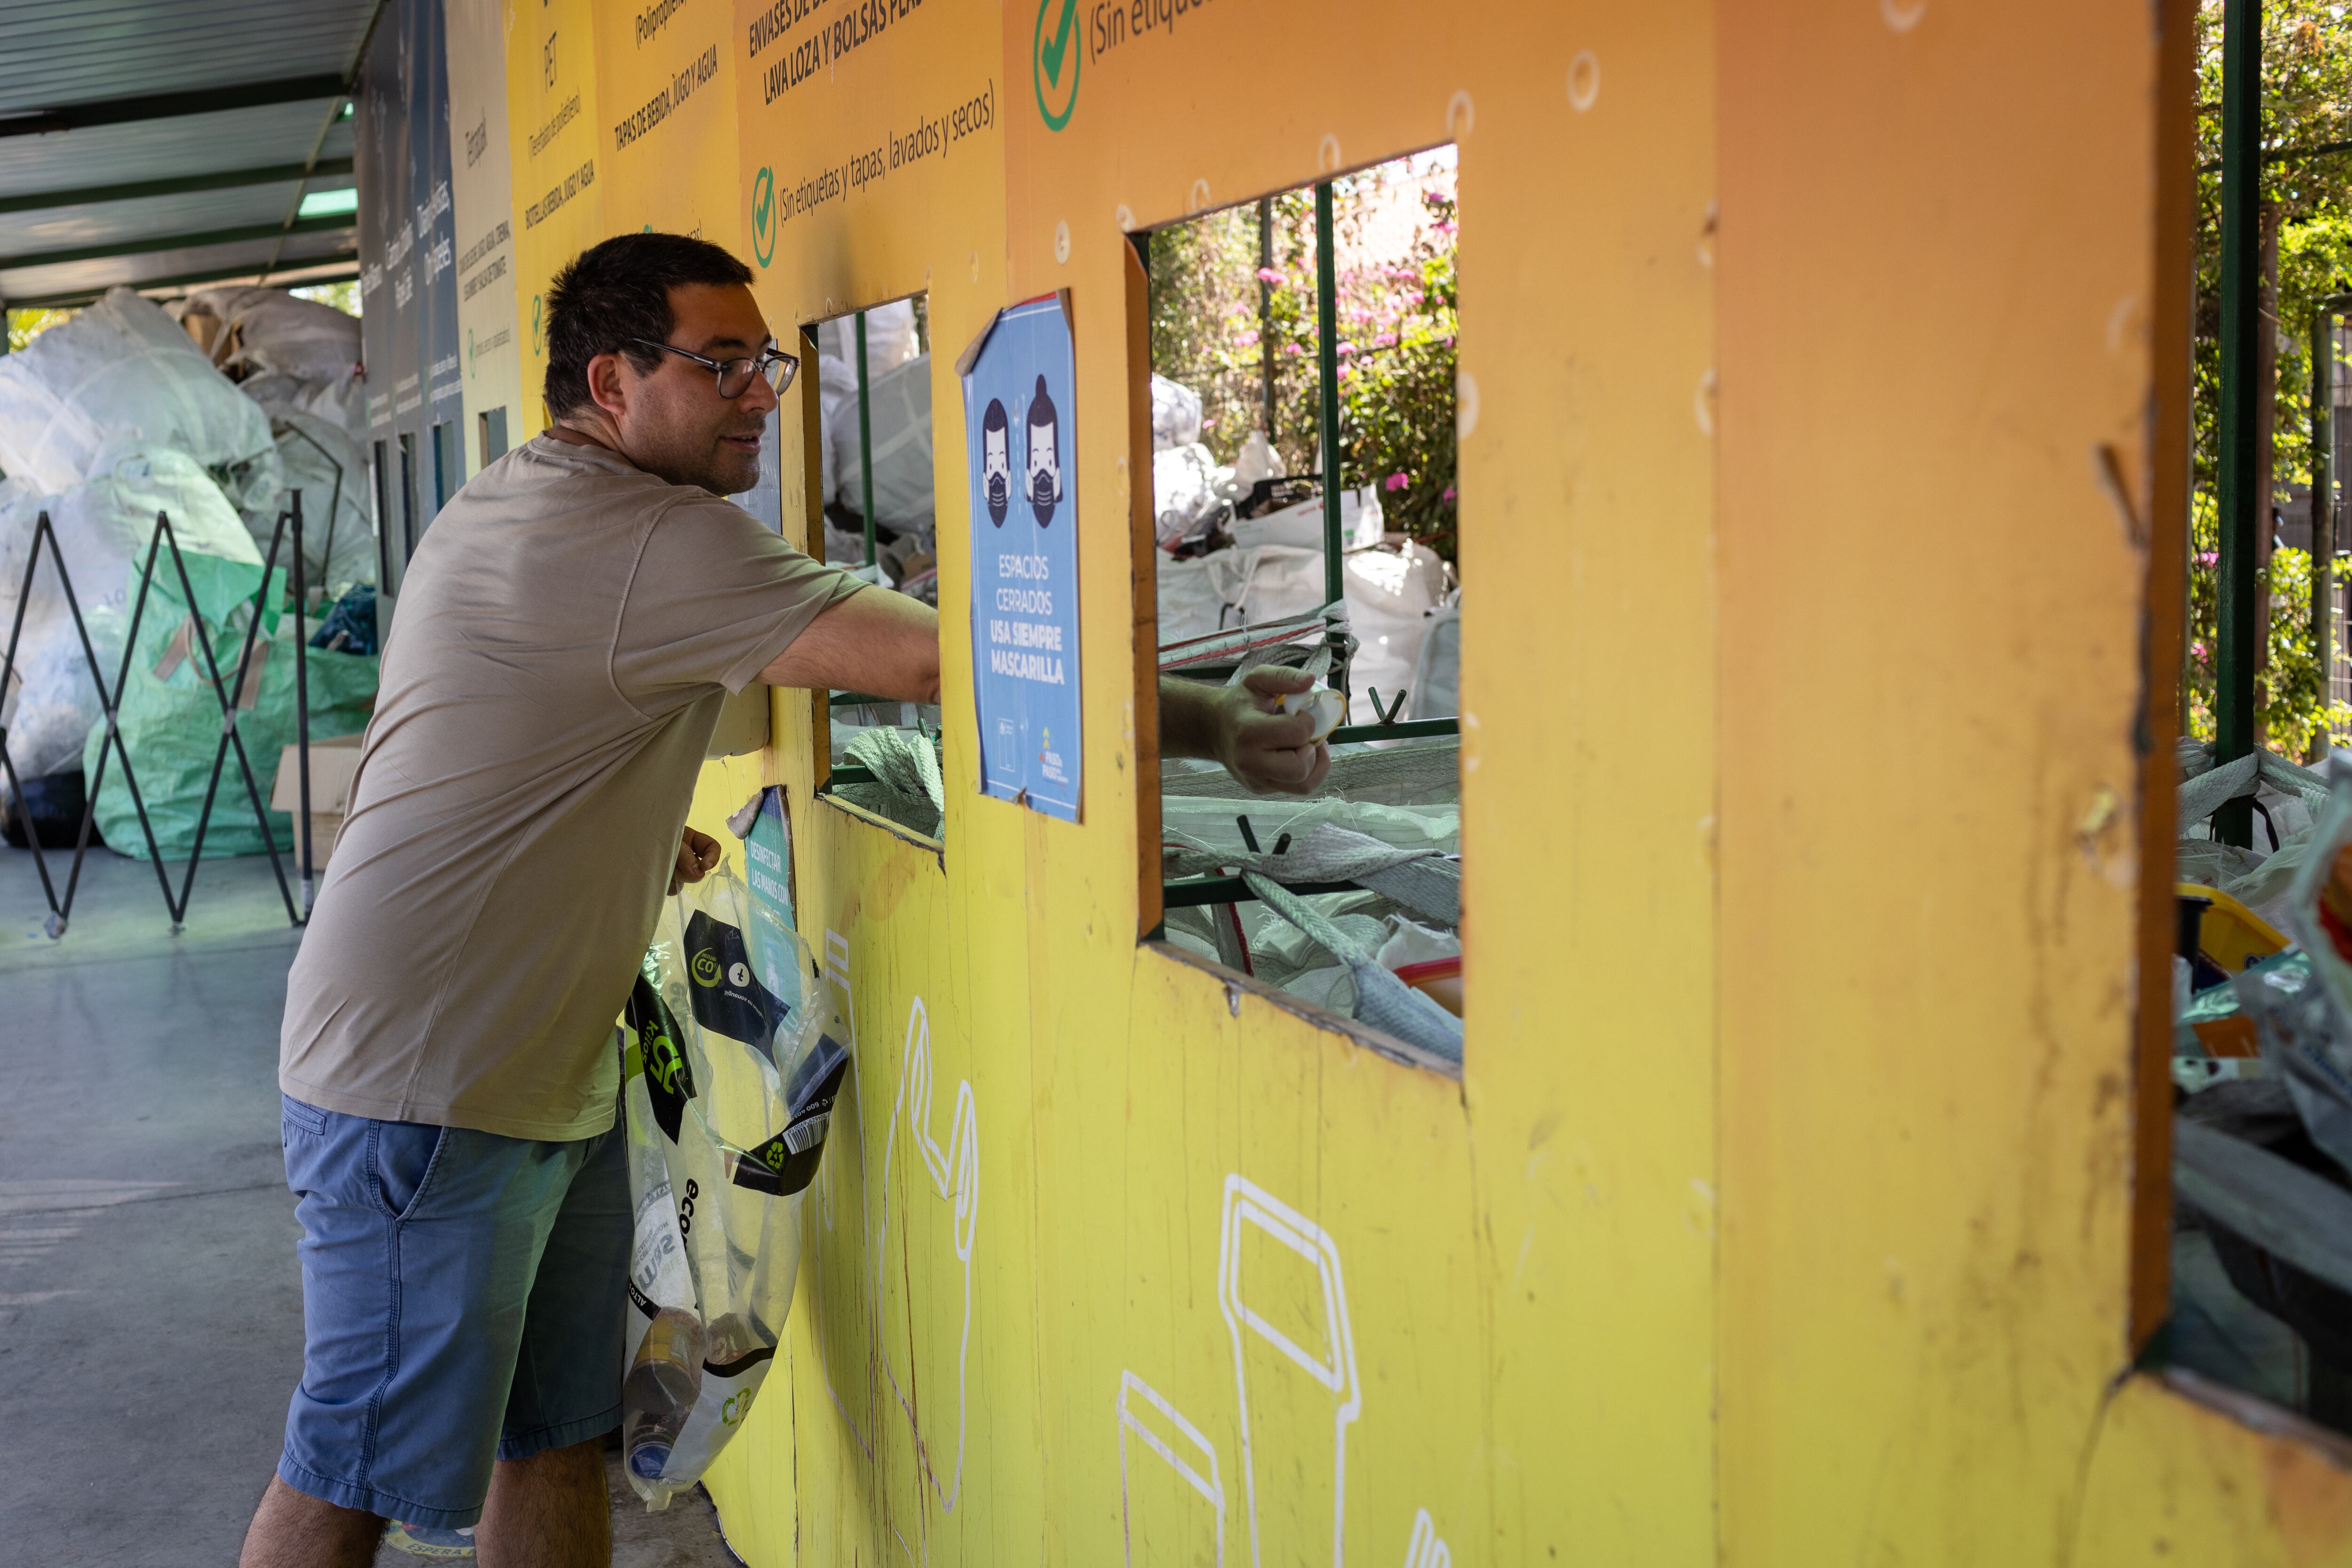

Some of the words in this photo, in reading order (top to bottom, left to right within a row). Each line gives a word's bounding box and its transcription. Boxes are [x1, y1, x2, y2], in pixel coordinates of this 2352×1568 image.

[750, 0, 792, 58] ENVASES
[764, 57, 789, 105] LAVA
[791, 35, 820, 87] LOZA
[823, 26, 831, 65] Y
[834, 0, 887, 59] BOLSAS
[615, 114, 636, 151] TAPAS
[637, 106, 647, 137] DE
[673, 68, 690, 110] JUGO
[691, 62, 696, 92] Y
[697, 43, 717, 88] AGUA
[780, 187, 795, 228] (Sin
[796, 168, 840, 216] etiquetas
[842, 164, 848, 203] y
[850, 148, 885, 193] tapas,
[890, 115, 939, 171] lavados
[942, 114, 949, 159] y
[953, 78, 994, 141] secos)
[999, 554, 1049, 580] ESPACIOS
[996, 587, 1053, 616] CERRADOS
[990, 619, 1011, 644] USA
[1013, 621, 1063, 651] SIEMPRE
[991, 649, 1065, 685] MASCARILLA
[750, 840, 781, 873] DESINFECTAR
[752, 868, 761, 889] LAS
[761, 873, 778, 899] MANOS
[778, 884, 788, 906] CON
[641, 1020, 659, 1064] Kilos
[806, 1101, 819, 1111] 600
[788, 1121, 807, 1134] 690016
[406, 1544, 461, 1555] ESPERA
